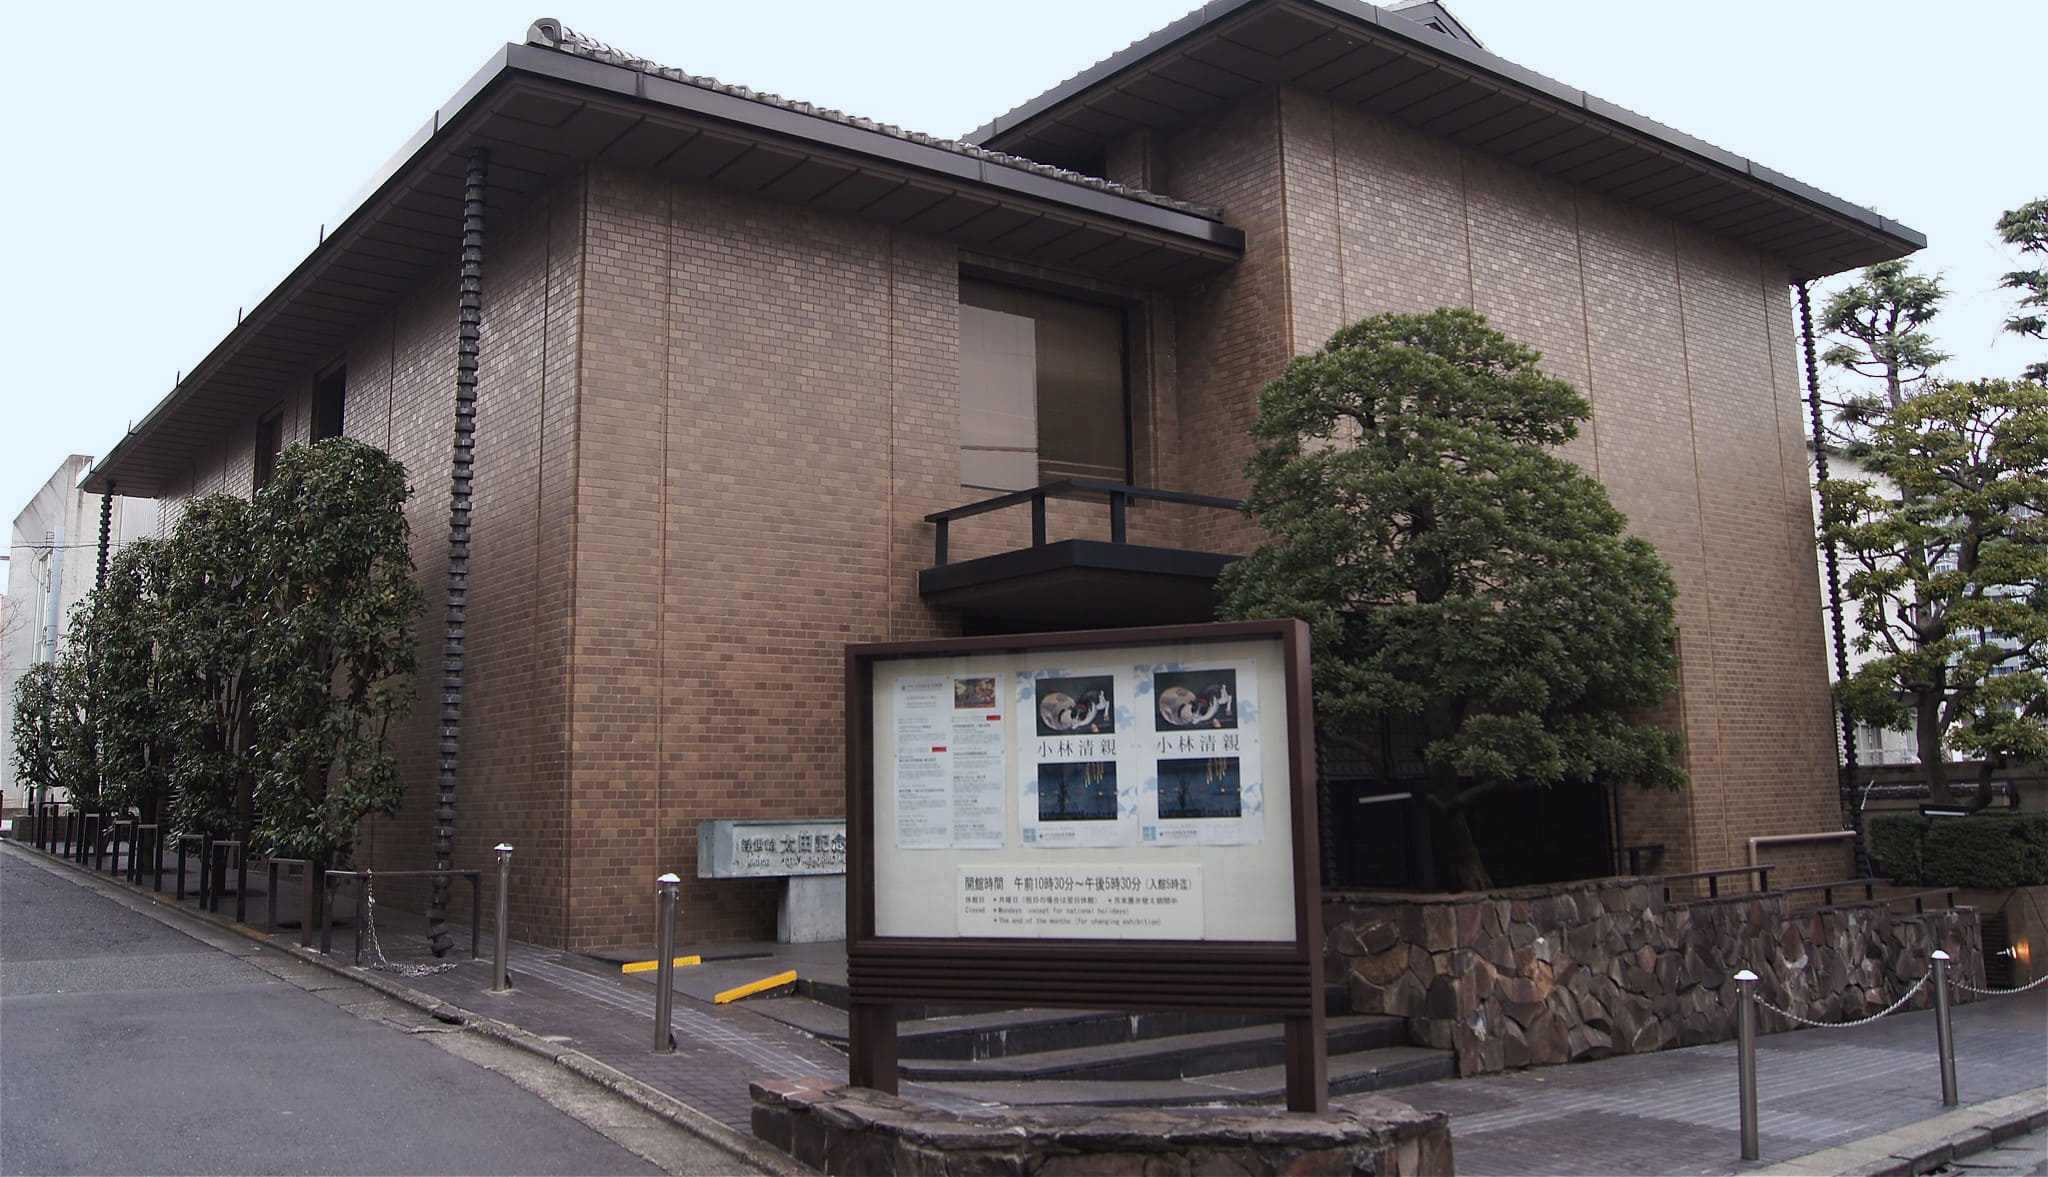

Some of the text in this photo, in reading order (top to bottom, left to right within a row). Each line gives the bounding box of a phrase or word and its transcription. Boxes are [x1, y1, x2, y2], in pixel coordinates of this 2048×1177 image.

[1037, 738, 1116, 759] 小林清親
[1156, 733, 1240, 754] 小林清親
[965, 876, 1004, 891] 開館時間
[965, 906, 985, 914] Closed
